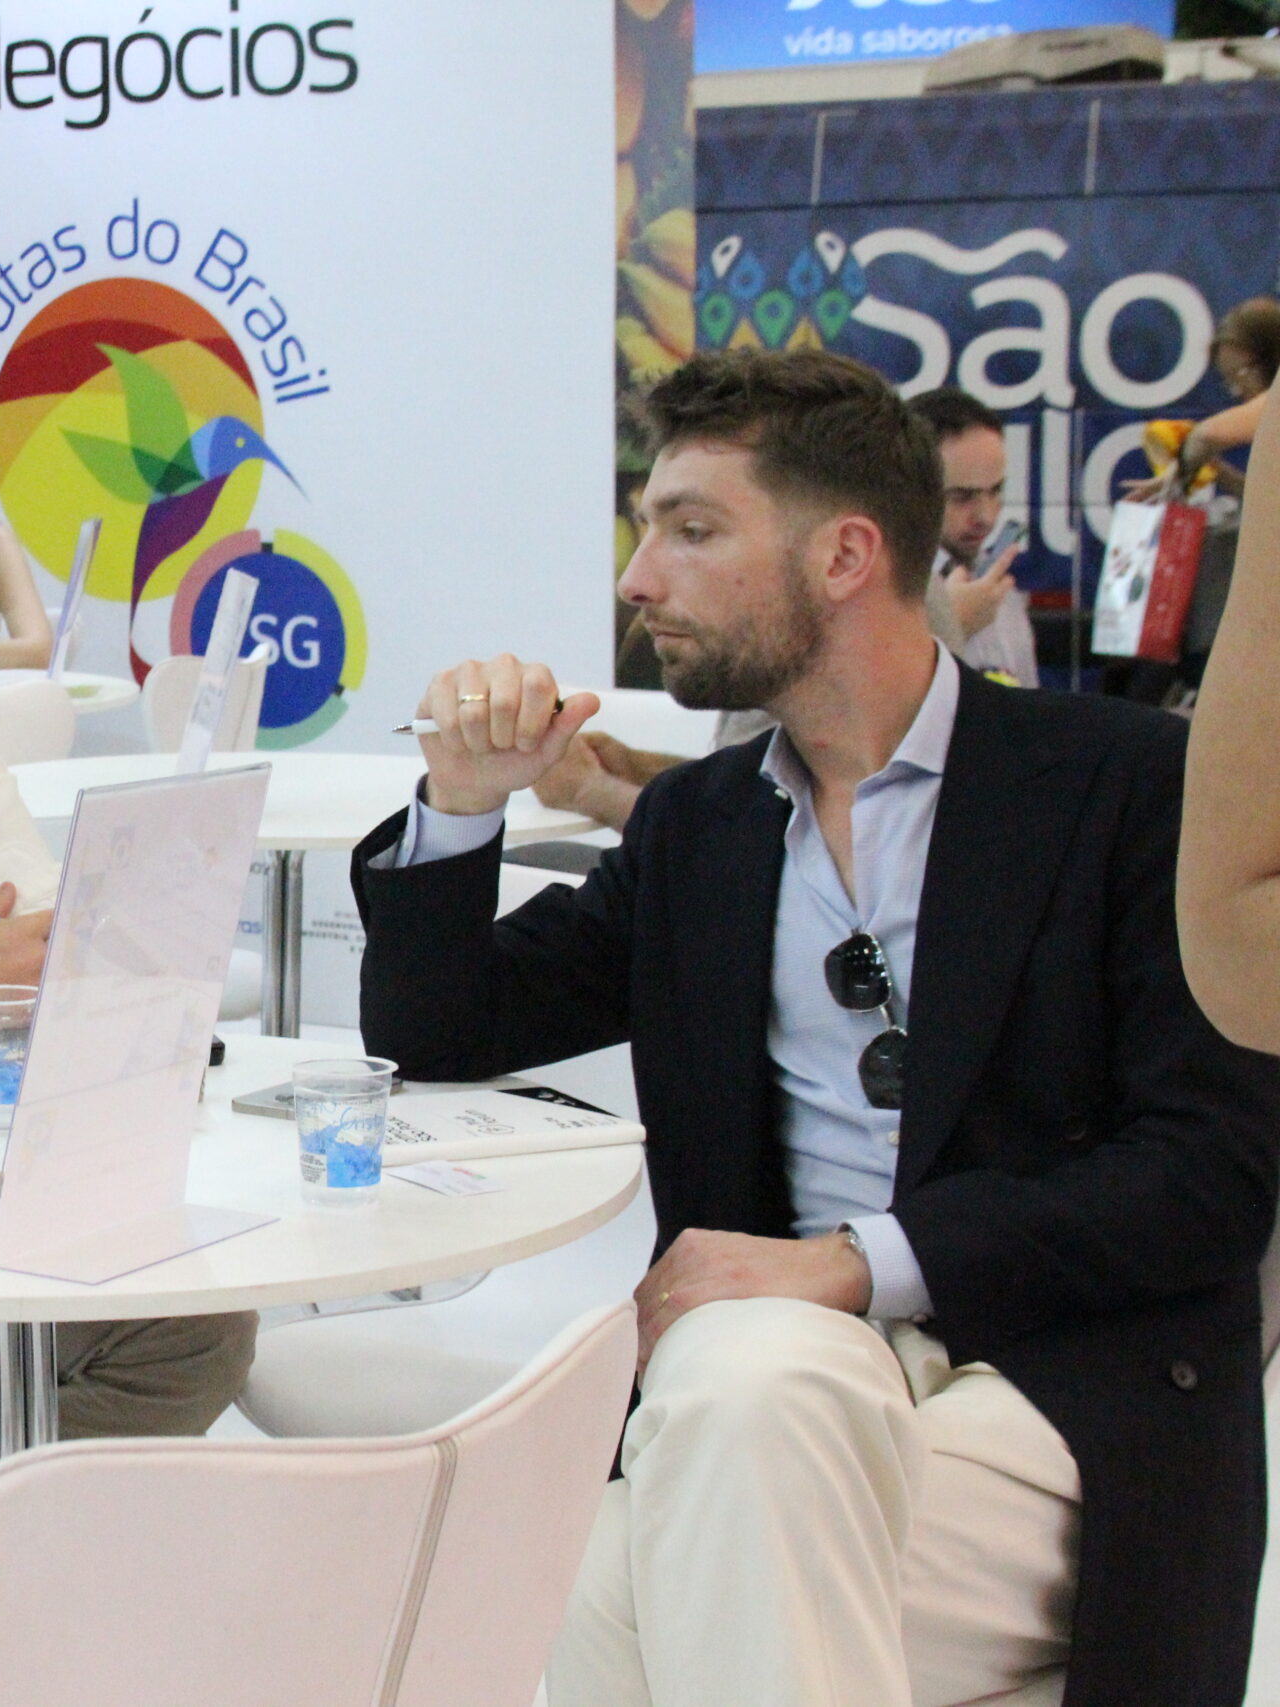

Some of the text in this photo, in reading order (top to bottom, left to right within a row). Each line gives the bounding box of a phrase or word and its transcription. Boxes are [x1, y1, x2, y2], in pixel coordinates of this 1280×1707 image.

[107, 197, 180, 266] do
[195, 228, 329, 405] Brasil
[851, 227, 1214, 410] São
[248, 614, 322, 669] SG
